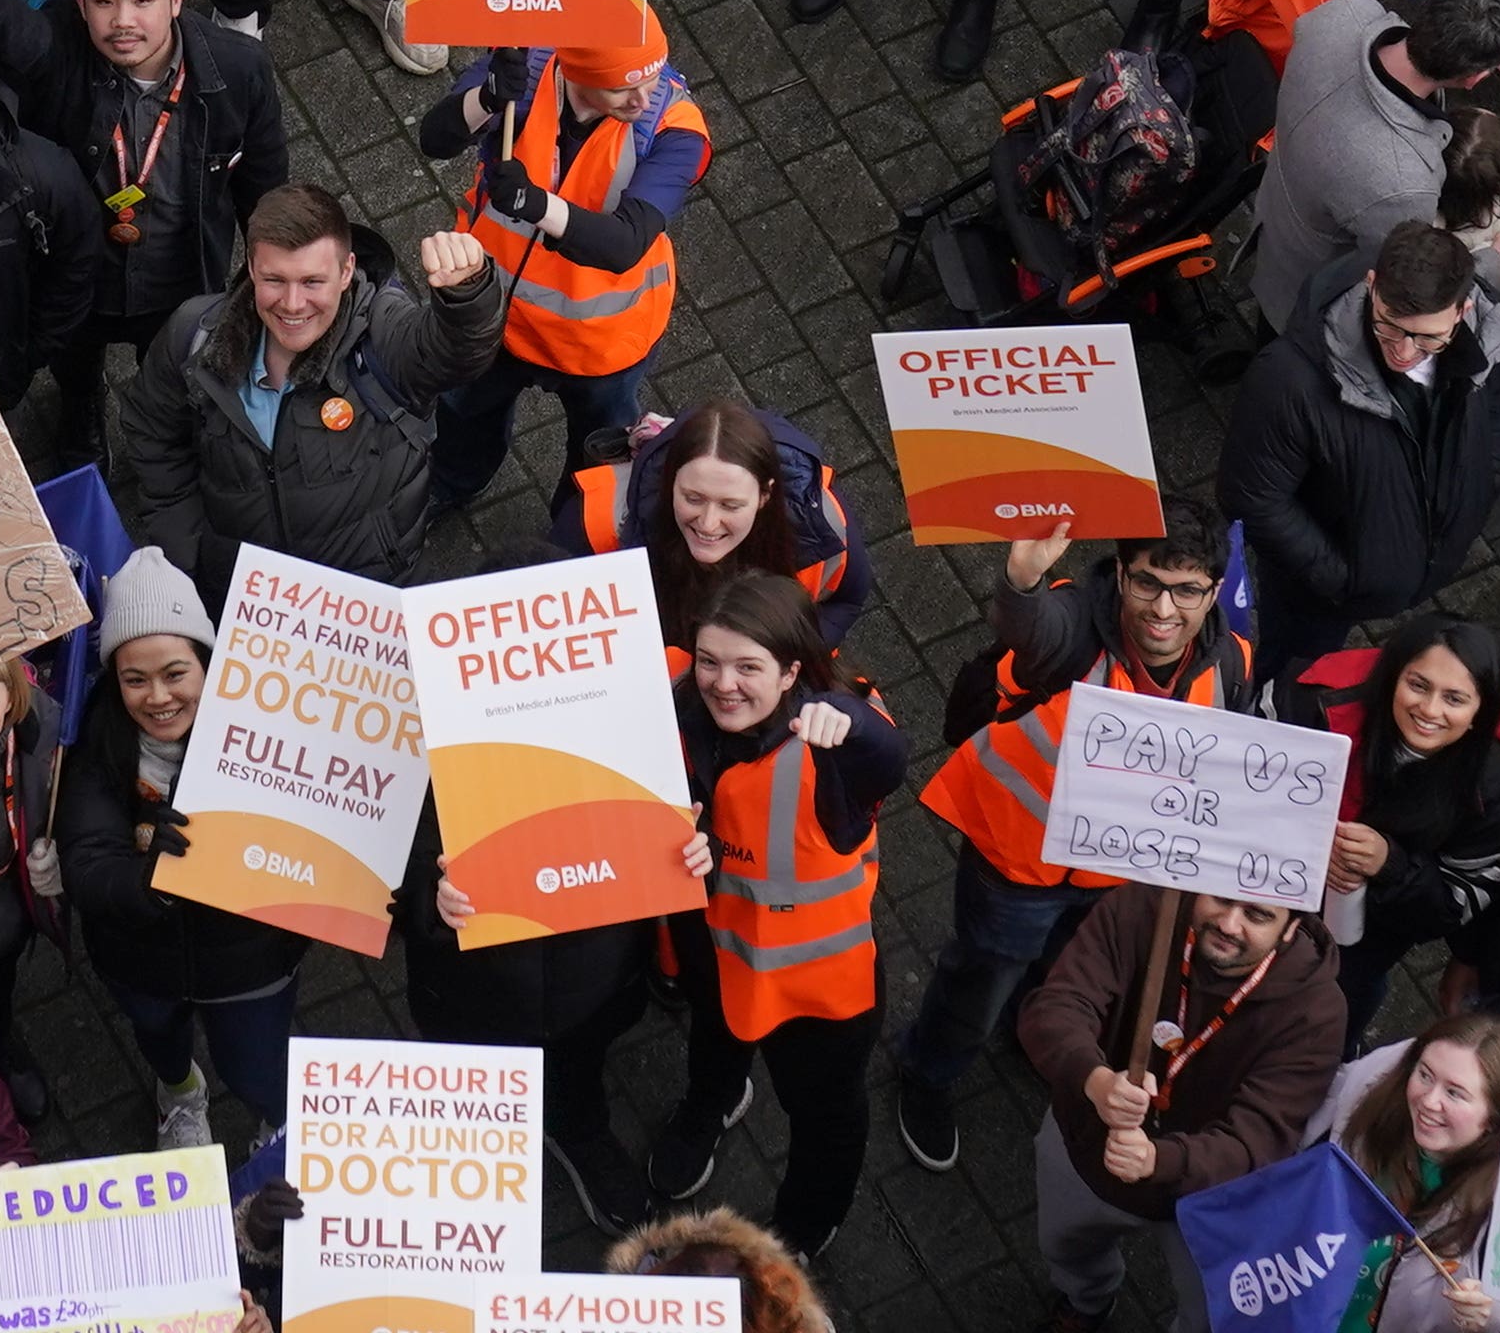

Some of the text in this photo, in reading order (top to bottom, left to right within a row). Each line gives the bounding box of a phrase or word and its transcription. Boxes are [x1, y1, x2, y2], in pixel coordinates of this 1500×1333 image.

[428, 582, 637, 649] OFFICIAL
[458, 629, 618, 690] PICKET
[485, 688, 607, 717] British Medical Association
[1084, 712, 1326, 805] PAY US
[1152, 786, 1220, 827] OR
[561, 859, 617, 889] BMA
[1070, 815, 1308, 896] LOSE US
